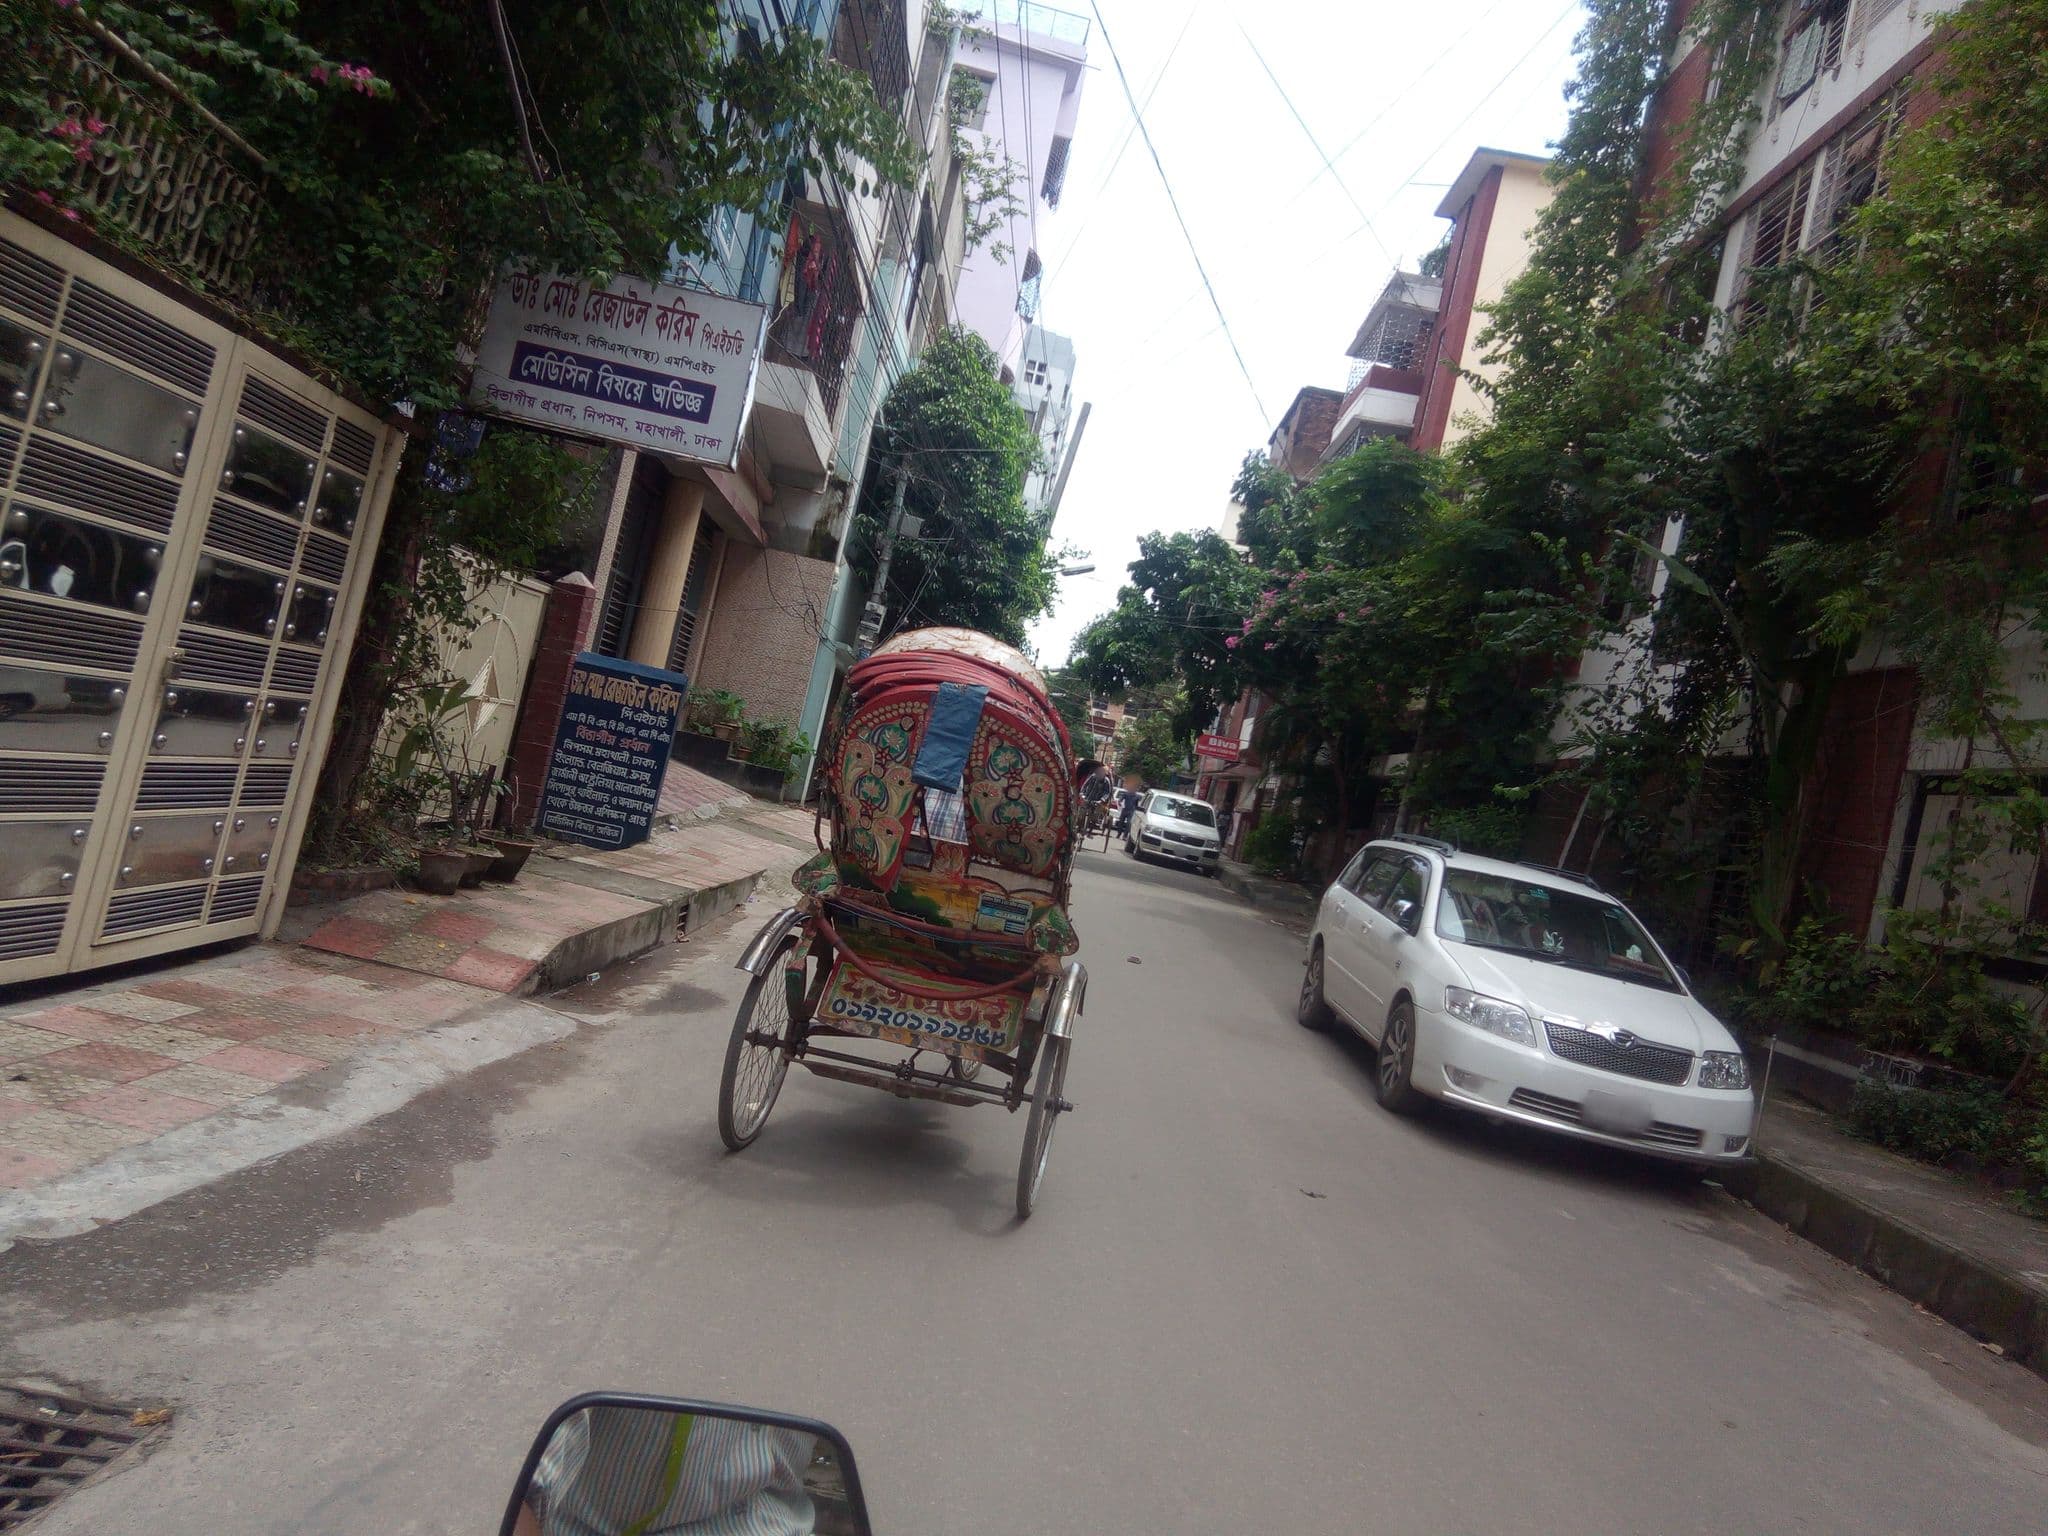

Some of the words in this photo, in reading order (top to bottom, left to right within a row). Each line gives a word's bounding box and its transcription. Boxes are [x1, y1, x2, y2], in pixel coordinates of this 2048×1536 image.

[523, 322, 581, 346] এমবিবিএস,
[664, 355, 716, 376] এমপিএইচ
[543, 280, 579, 320] মোঃ
[584, 286, 652, 333] রেজাউল
[655, 297, 700, 346] করিম
[700, 323, 745, 357] পিএইচডি
[521, 352, 592, 392] মেডিসিন
[595, 365, 647, 403] বিষয়ে
[651, 381, 704, 414] অভিজ্ঞ
[486, 384, 536, 409] বিভাগীয়
[540, 399, 577, 421] প্রধান,
[583, 405, 628, 433] নিপসম,
[634, 419, 688, 446] মহাখালী,
[693, 434, 722, 451] ঢাকা
[648, 683, 682, 716] করিম
